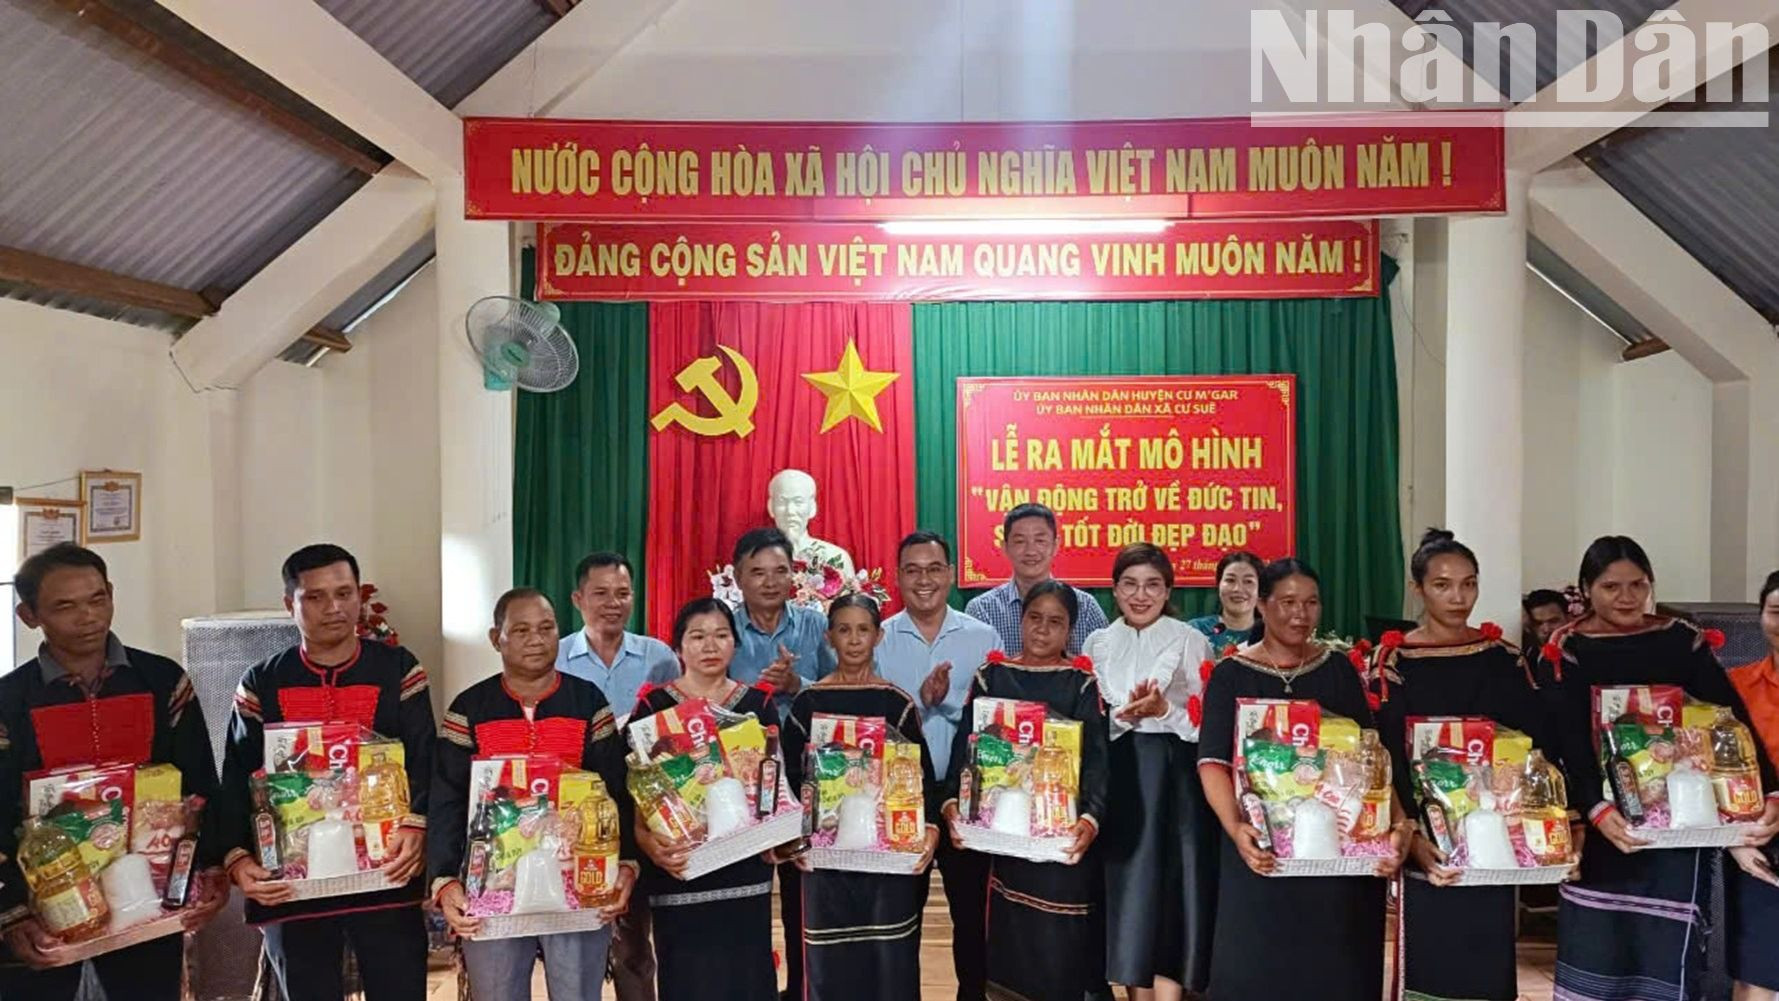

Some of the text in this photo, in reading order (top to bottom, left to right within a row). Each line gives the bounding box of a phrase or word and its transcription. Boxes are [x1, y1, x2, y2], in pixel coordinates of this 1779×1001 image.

[512, 135, 1452, 205] NƯỚC CỘNG HÒA XÃ HỘI CHỦ NGHĨA VIỆT NAM MUÔN NĂM !
[555, 231, 1362, 286] ĐẢNG CỘNG SẢN VIỆT NAM QUANG VINH MUÔN NĂM !
[1033, 391, 1060, 401] BAN
[1063, 389, 1099, 401] NHÂN
[1102, 389, 1129, 401] DÂN
[1132, 389, 1173, 402] HUYỆN
[1056, 405, 1082, 415] BAN
[1085, 403, 1122, 414] NHÂN
[1124, 403, 1151, 414] DÂN
[991, 422, 1262, 471] LỄ RA MẮT MÔ HÌNH
[1037, 484, 1098, 516] ĐỘNG
[1105, 480, 1148, 511] TRỞ
[1154, 480, 1181, 511] VỀ
[1187, 482, 1233, 511] ĐỨC
[1240, 486, 1283, 512] TIN,
[1062, 515, 1261, 551] TỐT ĐỜI ĐẸP ĐẠO"
